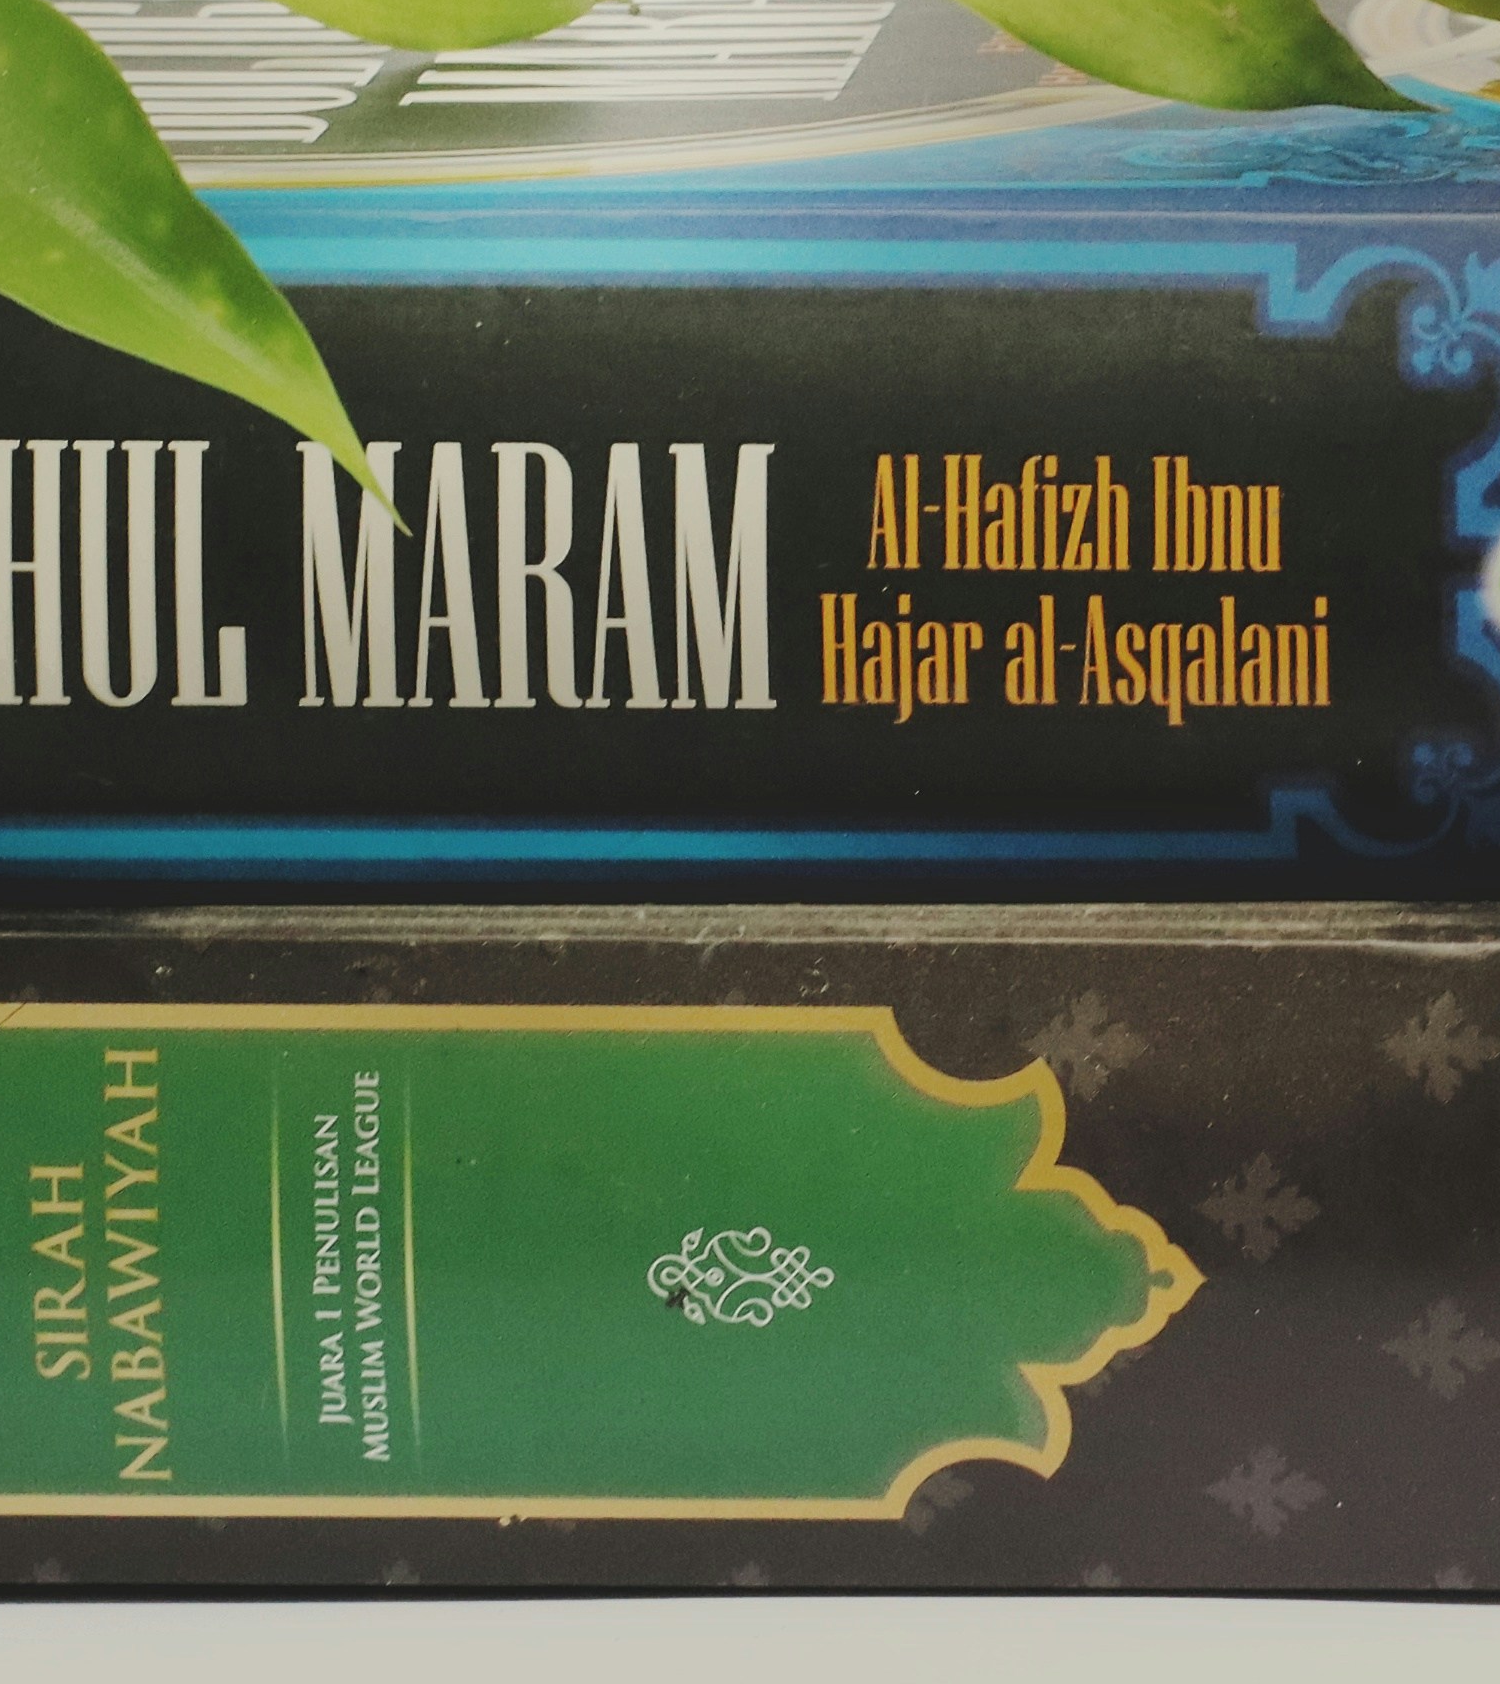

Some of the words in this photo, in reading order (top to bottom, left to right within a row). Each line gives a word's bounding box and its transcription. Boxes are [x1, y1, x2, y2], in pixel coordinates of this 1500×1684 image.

[296, 440, 777, 710] MARAM
[866, 453, 1131, 571] Al-Hafizh
[1152, 455, 1282, 573] Ibnu
[820, 593, 984, 725] Hajar
[1005, 594, 1331, 726] al-Asqalani
[351, 1070, 380, 1195] LEAGUE
[104, 1046, 173, 1483] NABAWIYAH
[312, 1114, 342, 1297] PENULISAN
[354, 1206, 383, 1334] WORLD
[28, 1161, 92, 1381] SIRAH
[315, 1331, 354, 1425] JUARA
[360, 1338, 391, 1463] MUSLIM
